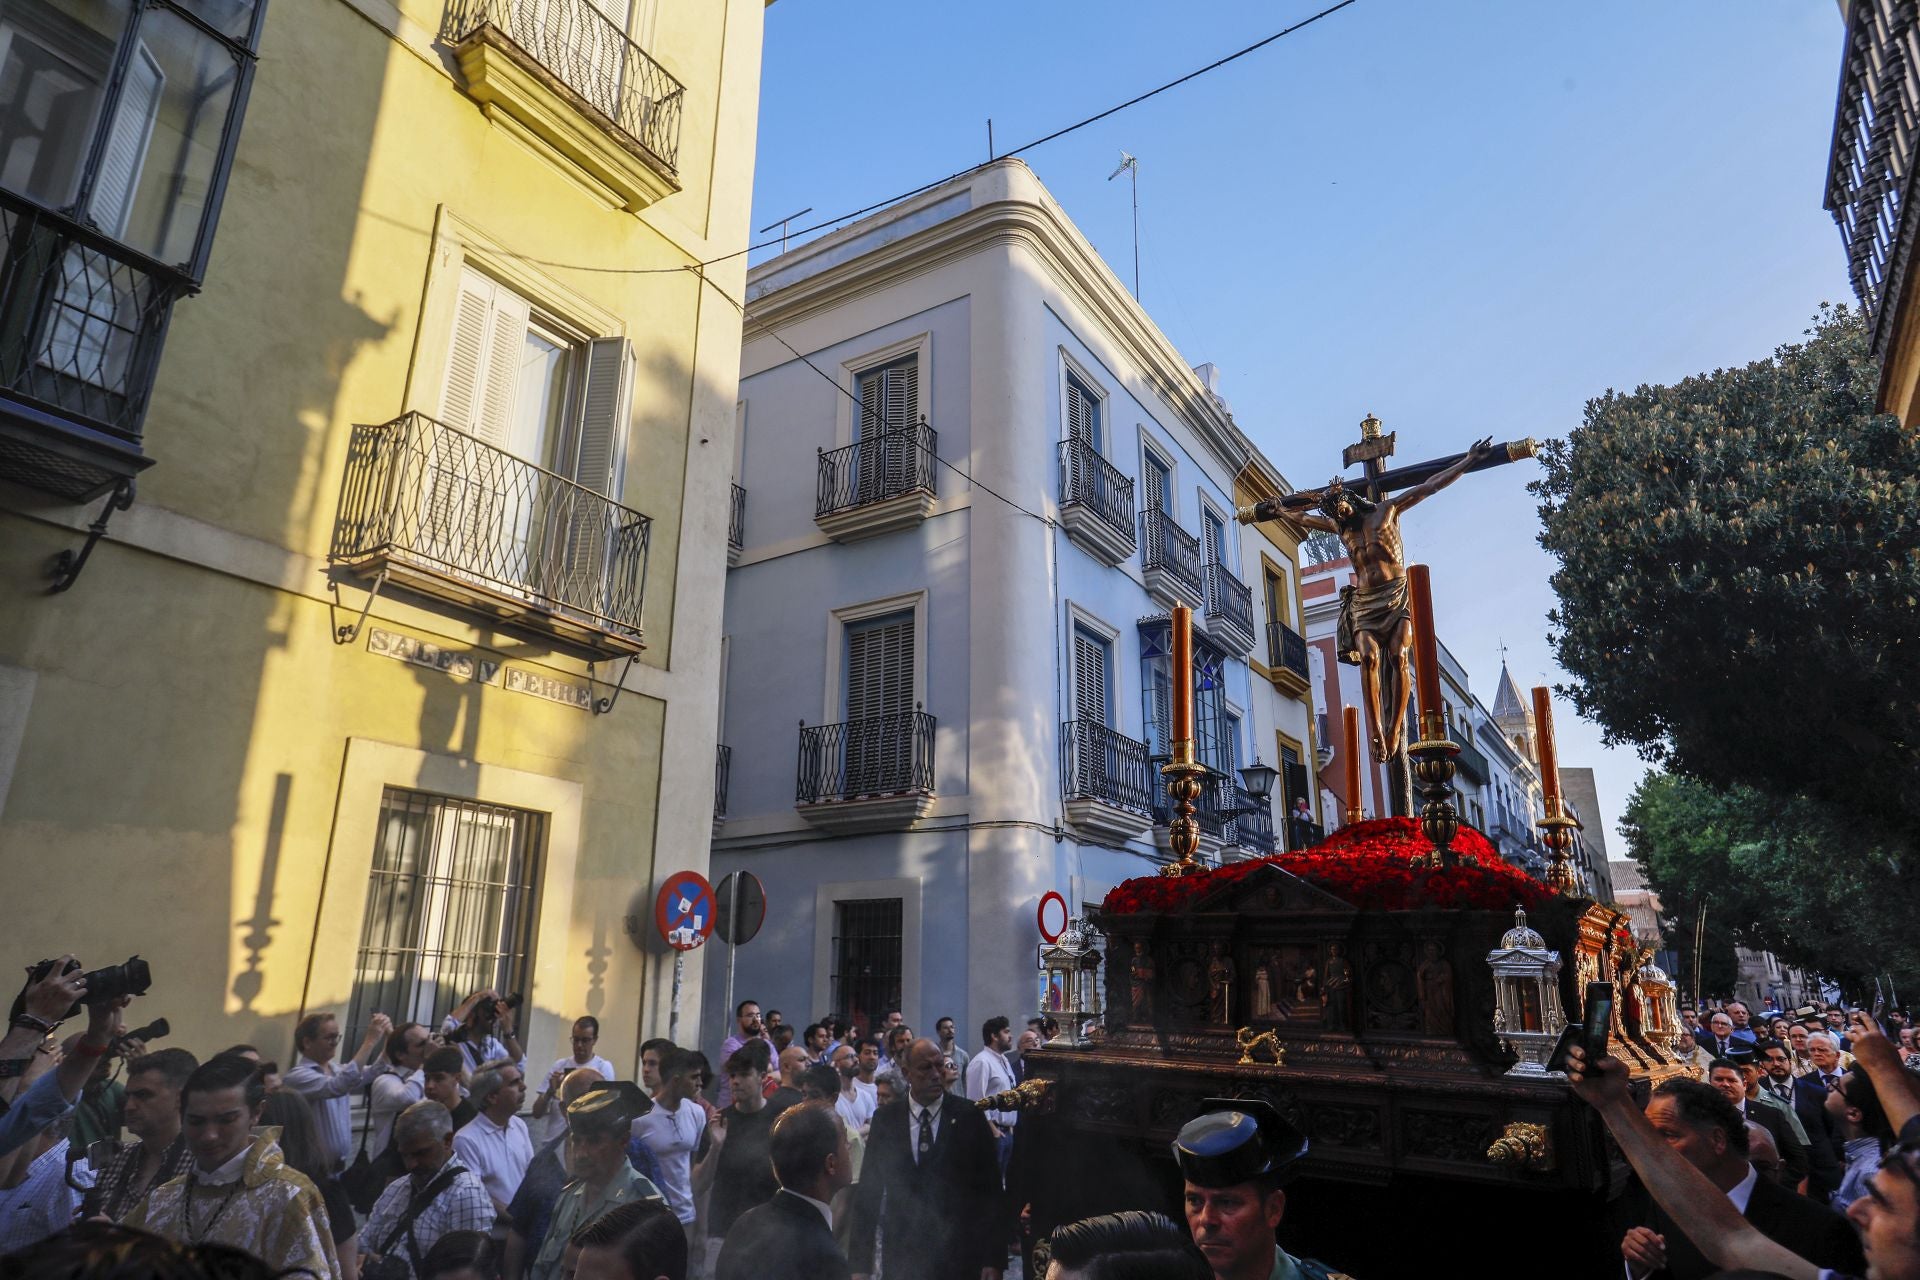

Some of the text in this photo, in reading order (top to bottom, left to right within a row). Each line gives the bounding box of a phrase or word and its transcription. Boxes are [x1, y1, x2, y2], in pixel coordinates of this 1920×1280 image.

[371, 630, 590, 707] SALES Y FERRE
